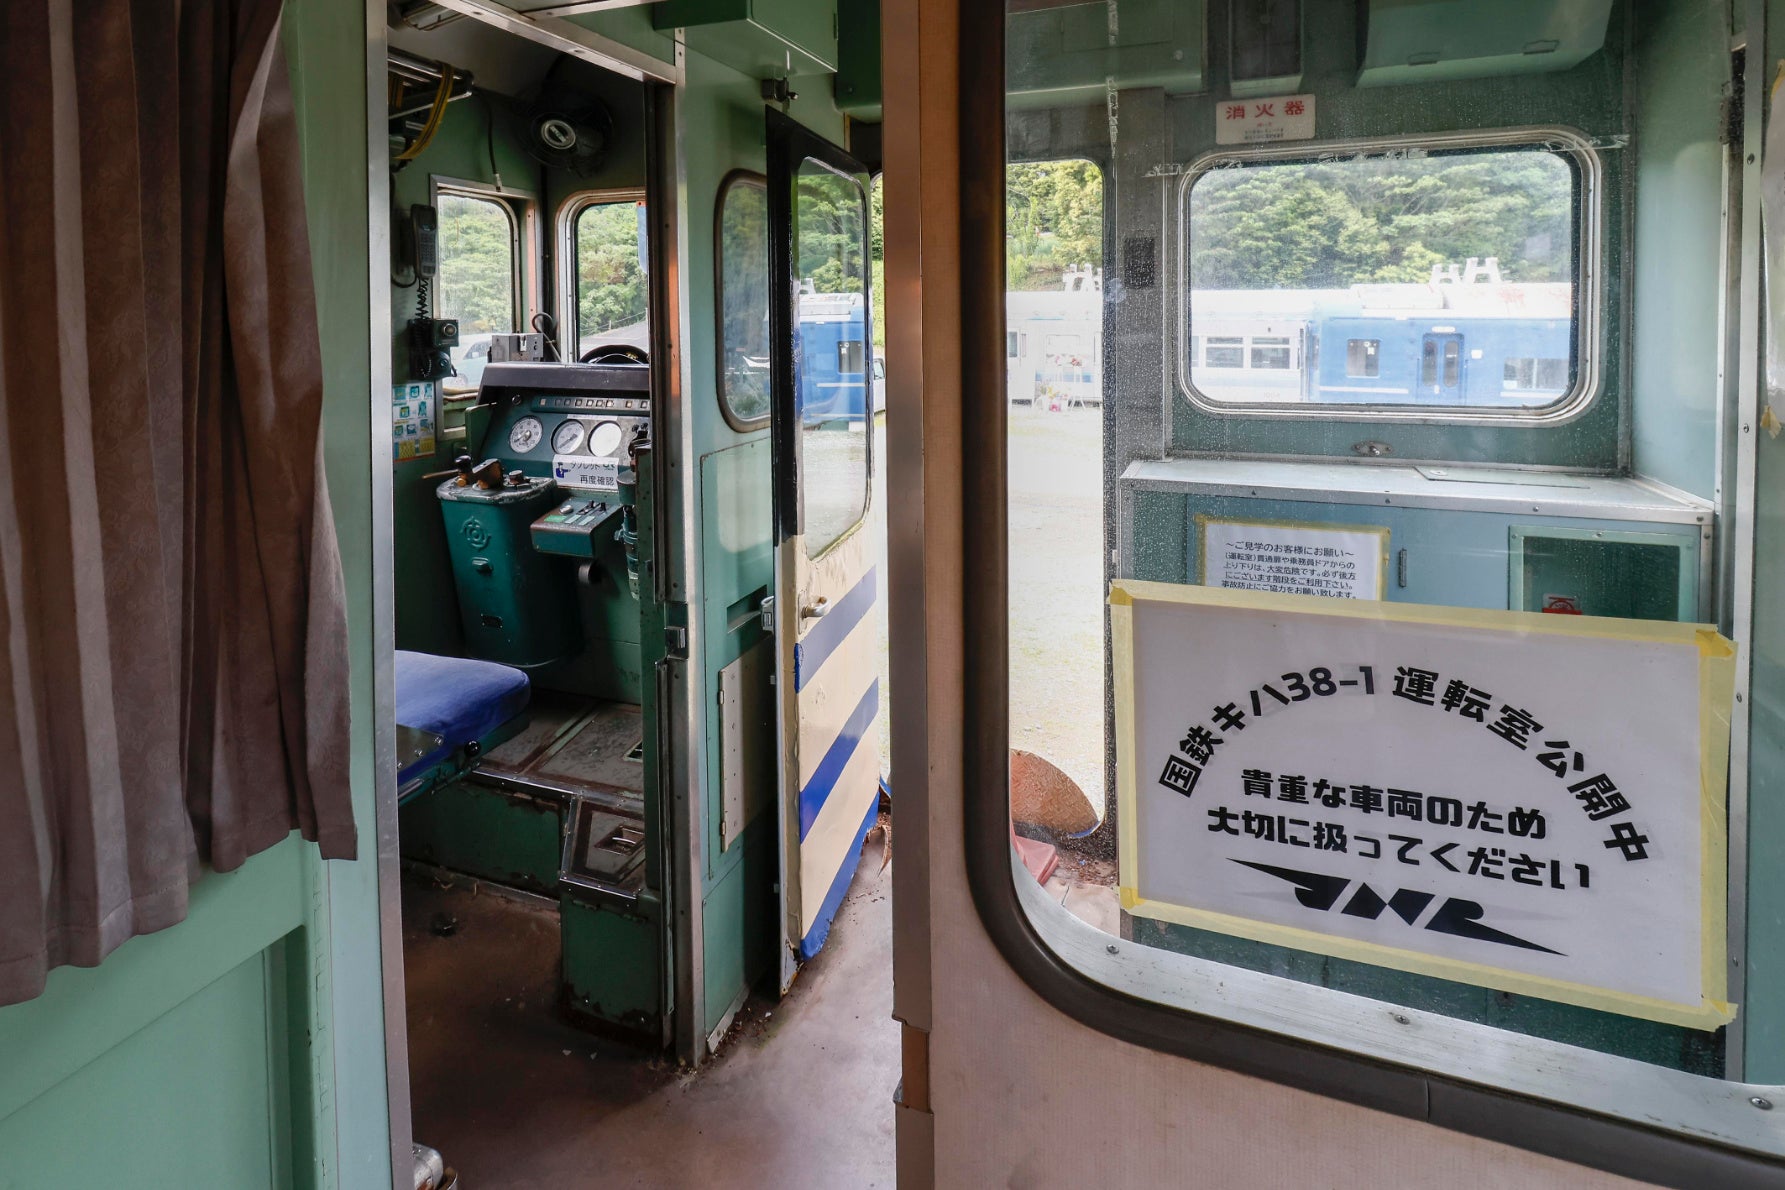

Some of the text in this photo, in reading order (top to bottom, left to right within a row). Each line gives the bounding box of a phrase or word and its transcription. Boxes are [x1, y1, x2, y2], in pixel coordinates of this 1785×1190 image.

[1225, 100, 1305, 120] 消火器
[580, 474, 615, 486] 再度確認
[1240, 768, 1547, 841] 貴重な車両のため
[1207, 806, 1591, 890] 大切に扱ってください
